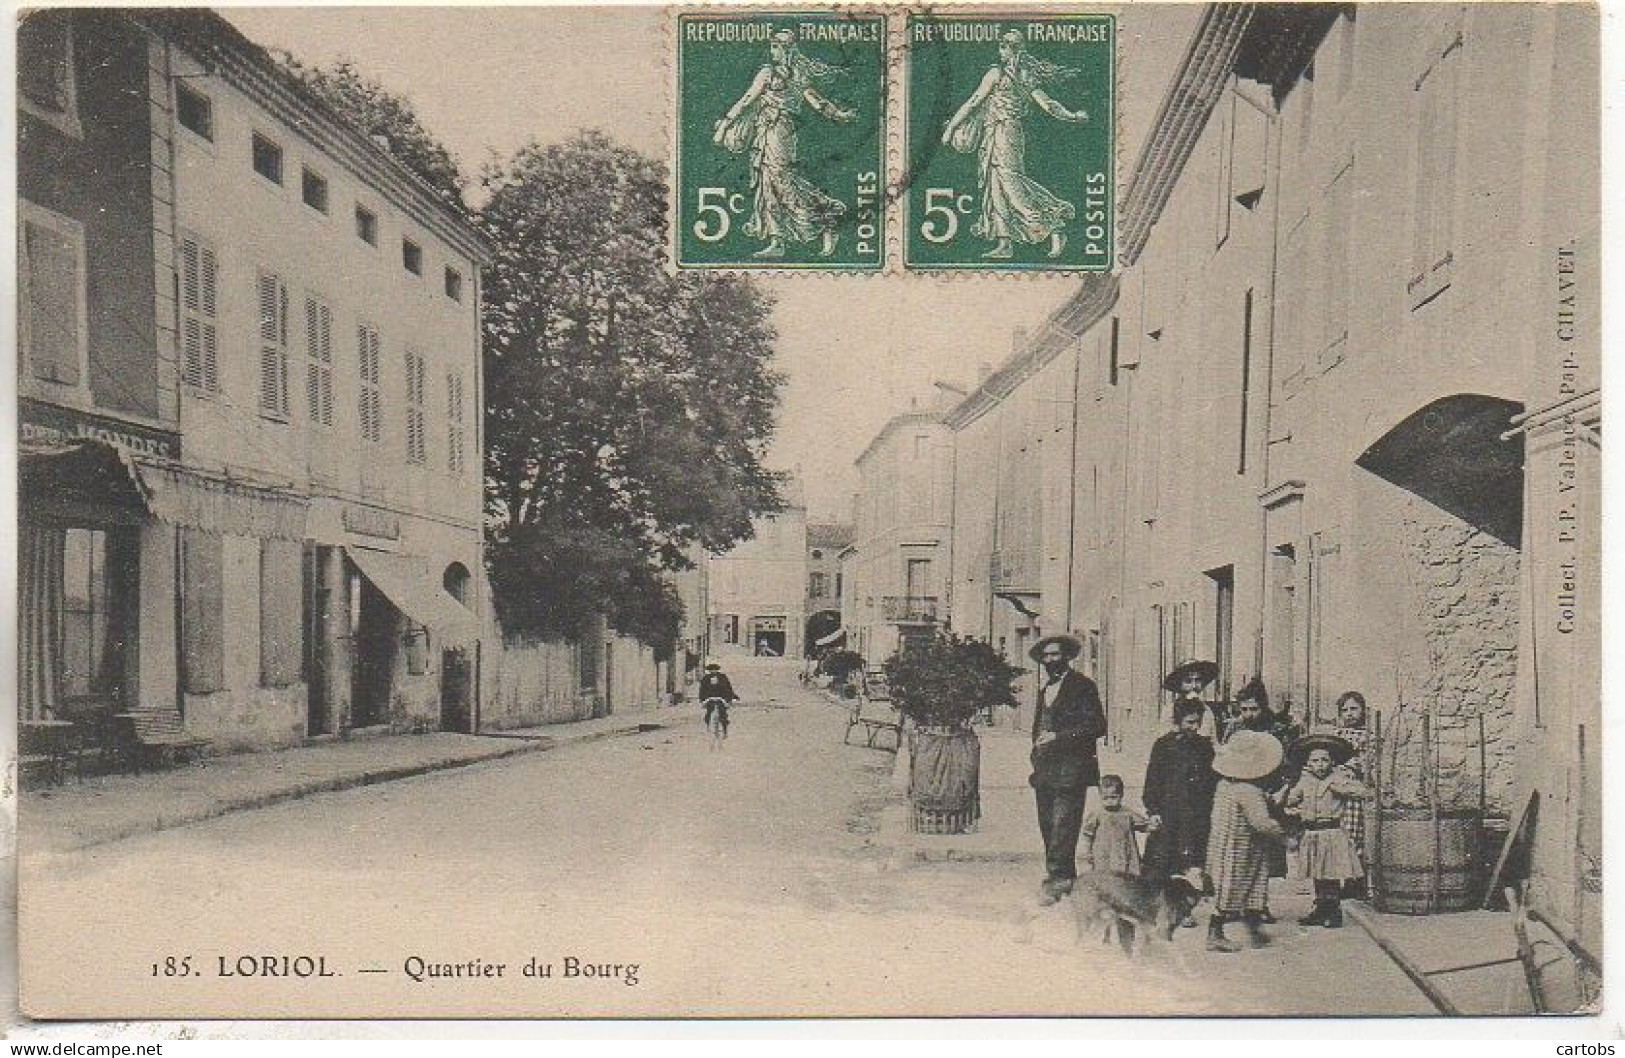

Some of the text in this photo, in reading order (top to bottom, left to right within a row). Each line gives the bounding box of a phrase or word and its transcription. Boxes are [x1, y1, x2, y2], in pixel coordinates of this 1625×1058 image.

[686, 23, 879, 45] REPUBLIQUE FRANÇAISE
[915, 23, 1108, 45] REPUBLIQUE FRANÇAISE
[857, 171, 876, 254] POSTES
[1086, 172, 1105, 255] POSTES
